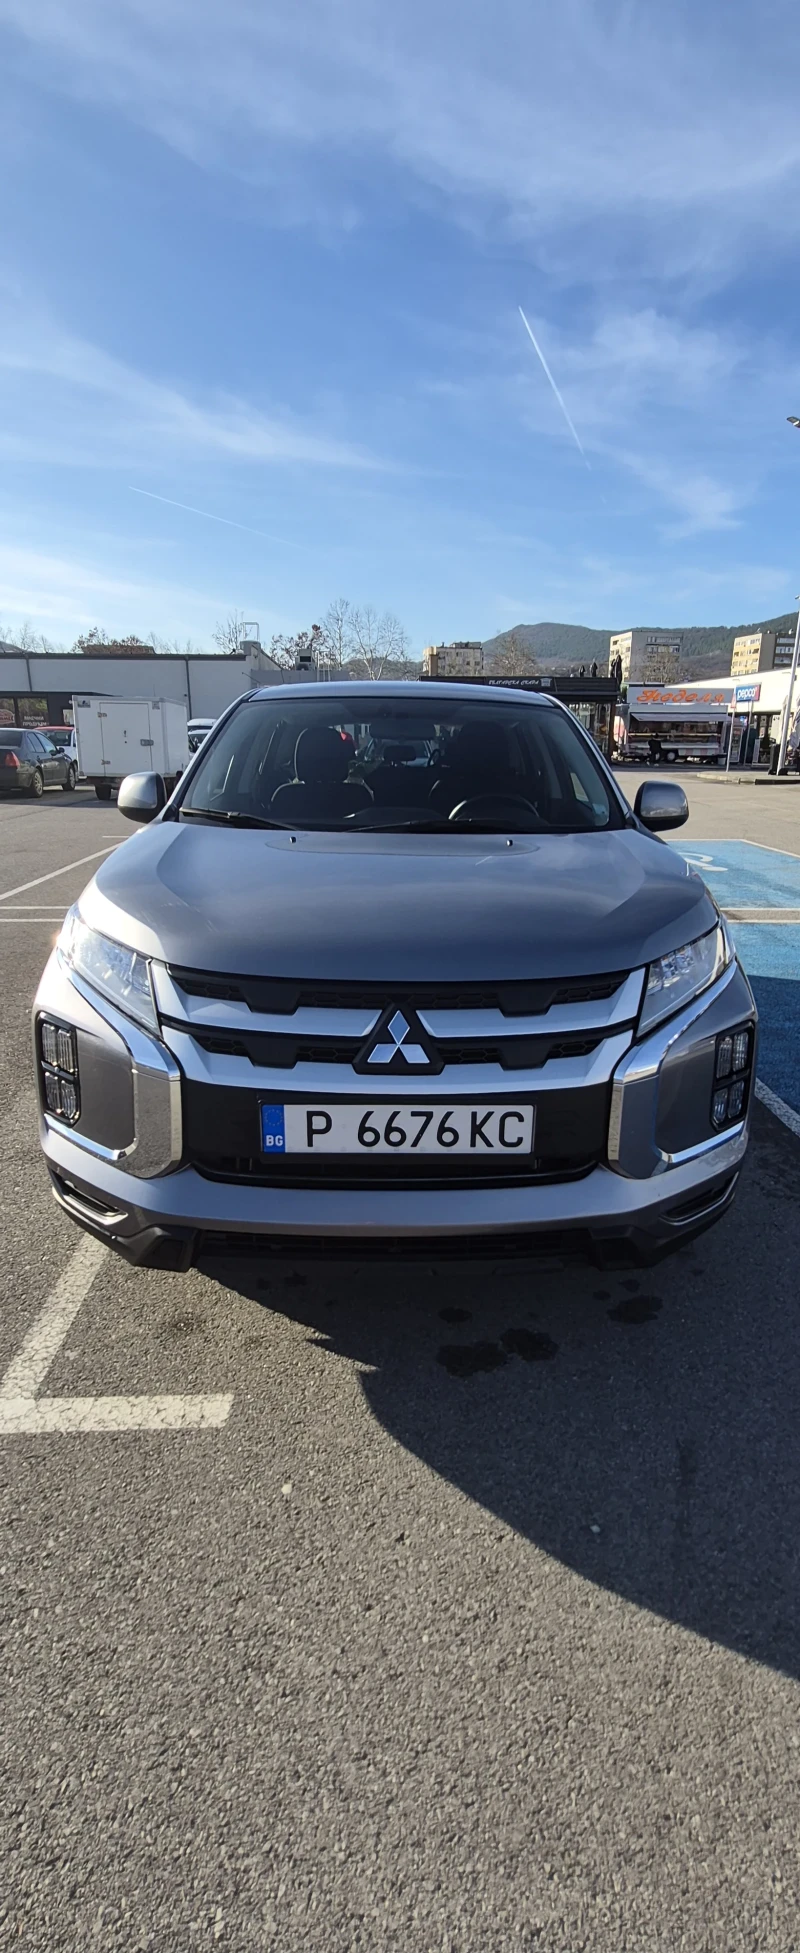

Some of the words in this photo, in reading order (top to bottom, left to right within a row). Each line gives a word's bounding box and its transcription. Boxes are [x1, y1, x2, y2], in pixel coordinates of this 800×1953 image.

[636, 688, 725, 704] Неделя
[737, 687, 756, 699] pepco
[306, 1110, 333, 1148] P
[357, 1110, 460, 1148] 6676
[469, 1110, 525, 1148] KC
[265, 1134, 284, 1147] BG
